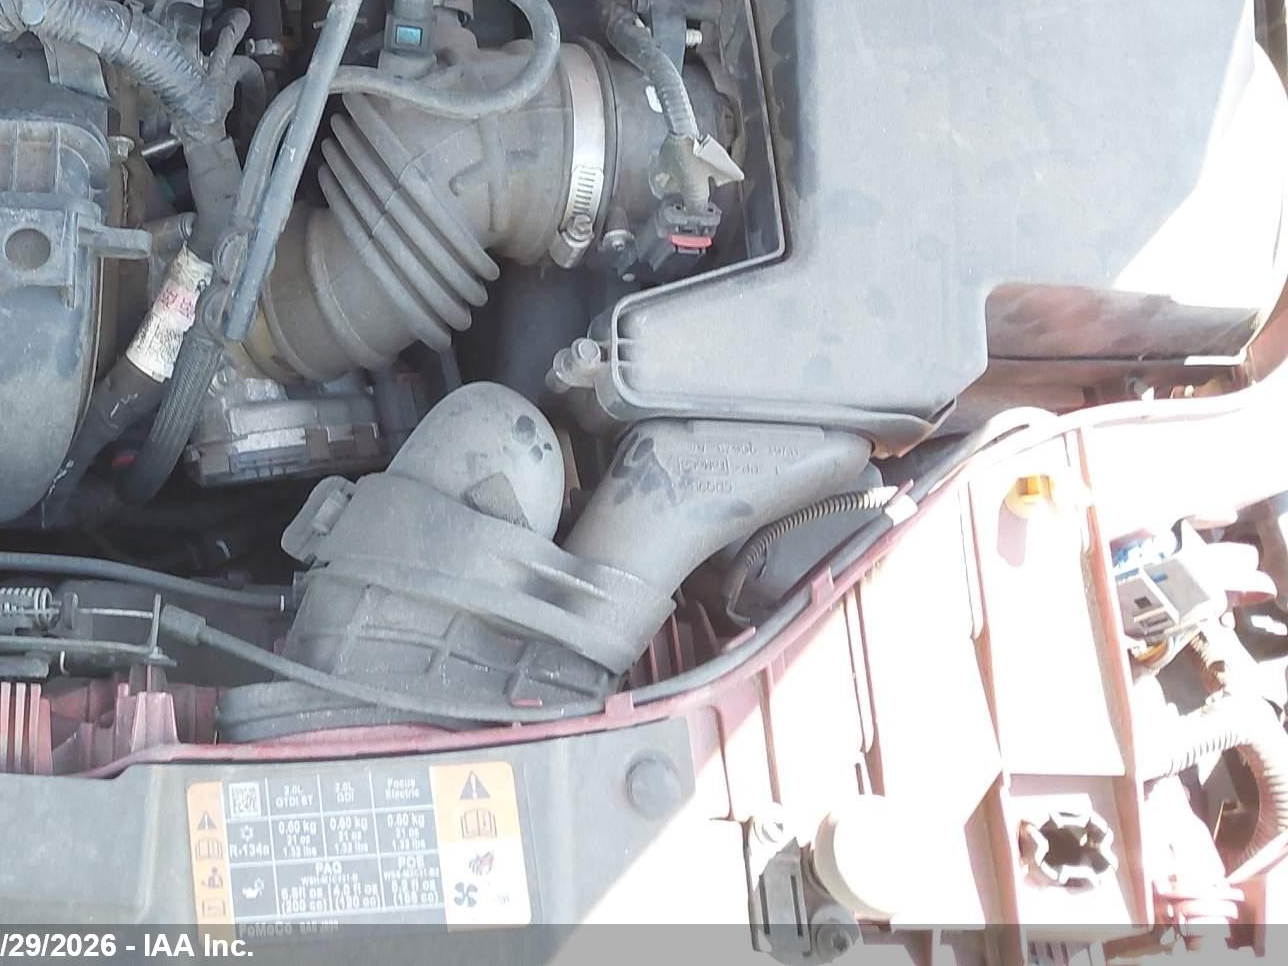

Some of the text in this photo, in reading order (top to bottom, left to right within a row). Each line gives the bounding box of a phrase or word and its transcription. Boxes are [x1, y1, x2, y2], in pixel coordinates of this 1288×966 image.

[303, 819, 317, 835] kg
[354, 815, 368, 831] kg
[411, 812, 425, 828] kg
